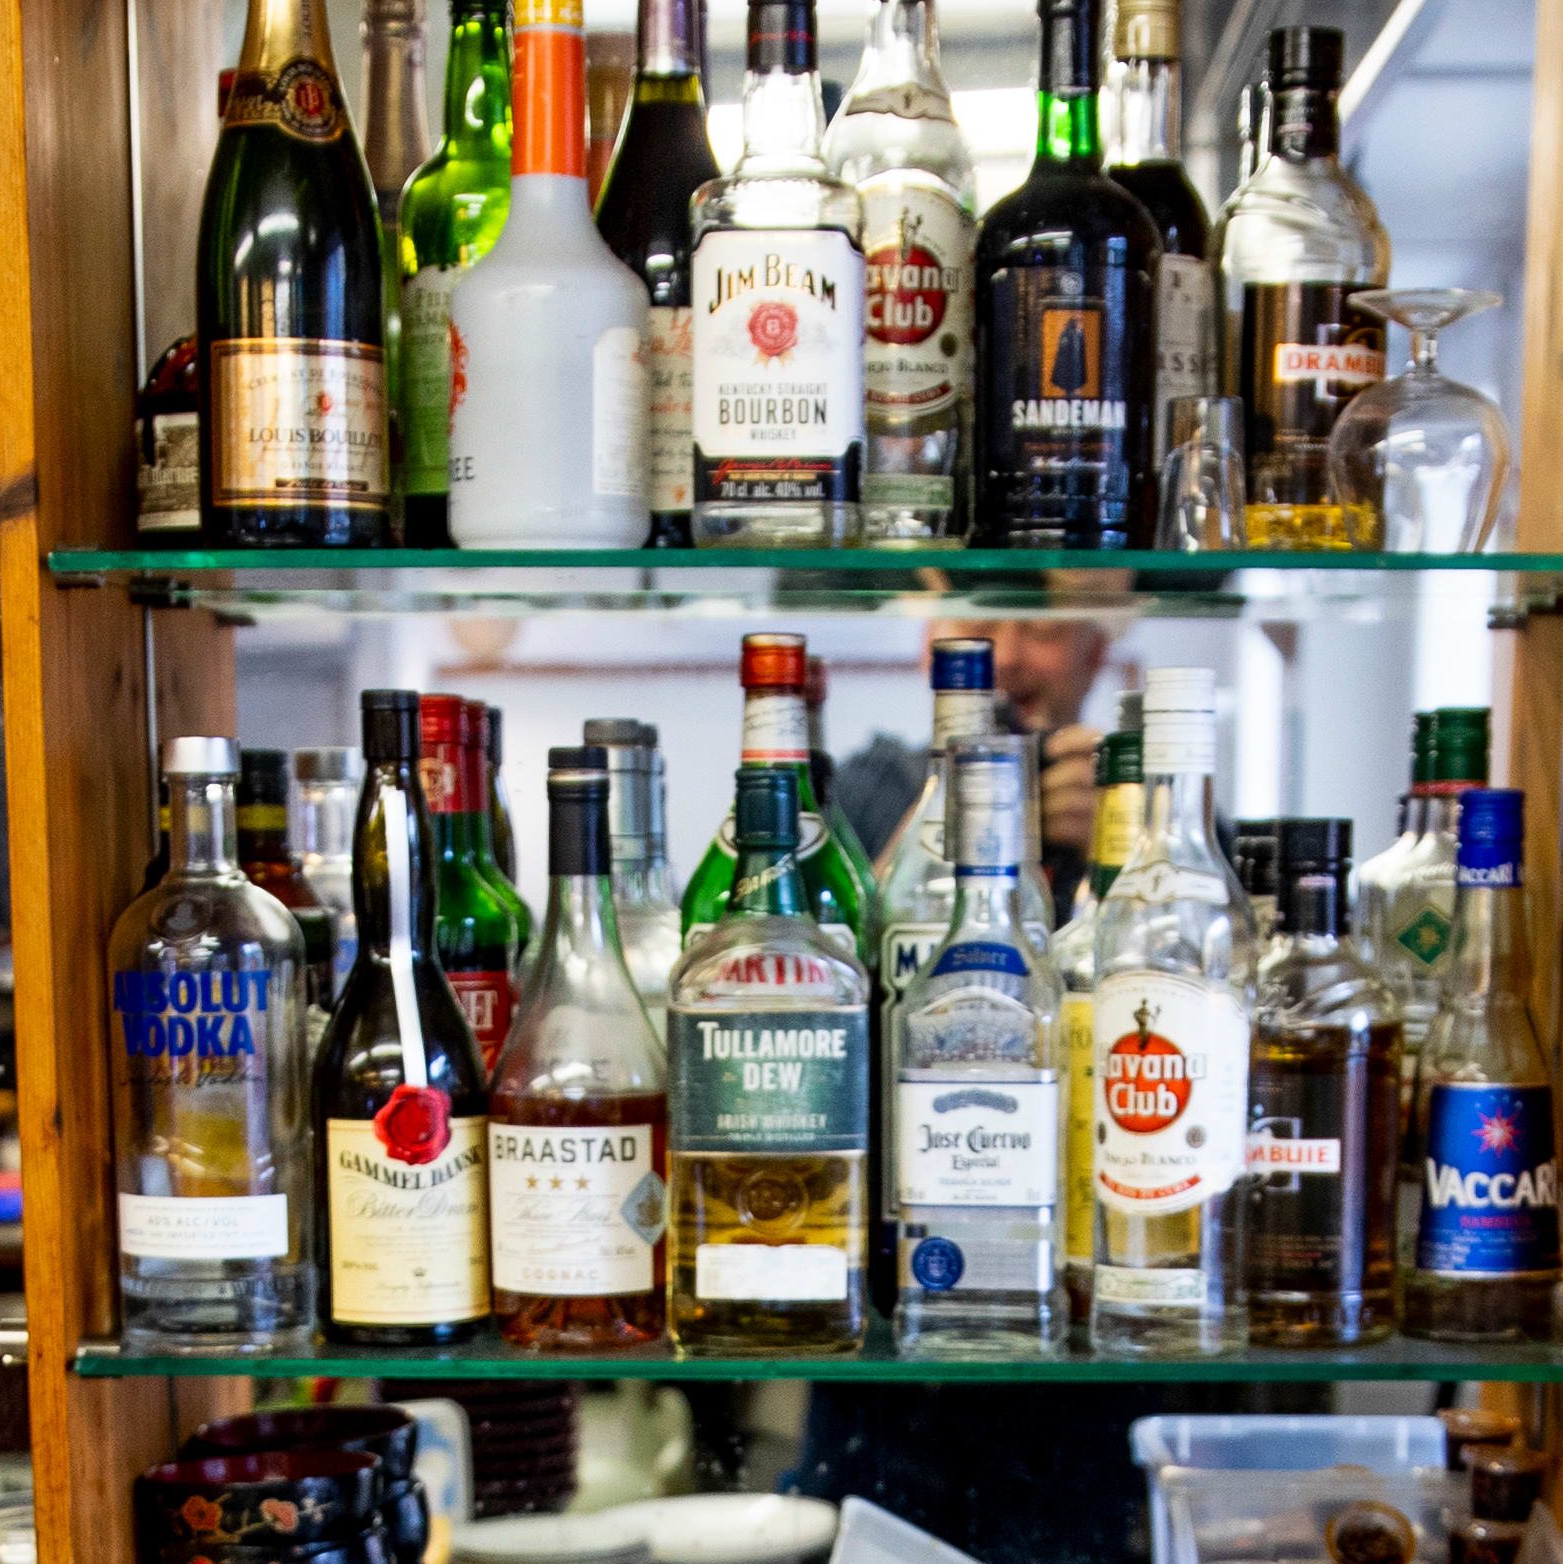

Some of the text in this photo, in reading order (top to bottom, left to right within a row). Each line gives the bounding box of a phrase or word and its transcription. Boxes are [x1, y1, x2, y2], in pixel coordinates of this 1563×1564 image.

[709, 252, 837, 314] JIM BEAM
[865, 262, 959, 293] avana
[719, 398, 827, 425] BOURBON
[1012, 400, 1127, 428] SANDEMAN
[250, 427, 306, 443] LOUIS
[113, 970, 273, 1014] ABSOLUT
[122, 1014, 256, 1057] VODKA
[696, 1020, 848, 1060] TULLAMORE
[742, 1061, 803, 1092] DEW
[1108, 1082, 1179, 1118] Club
[494, 1134, 637, 1164] BRAASTAD
[966, 1125, 1032, 1154] Cuervo
[339, 1148, 427, 1190] GAMMEL
